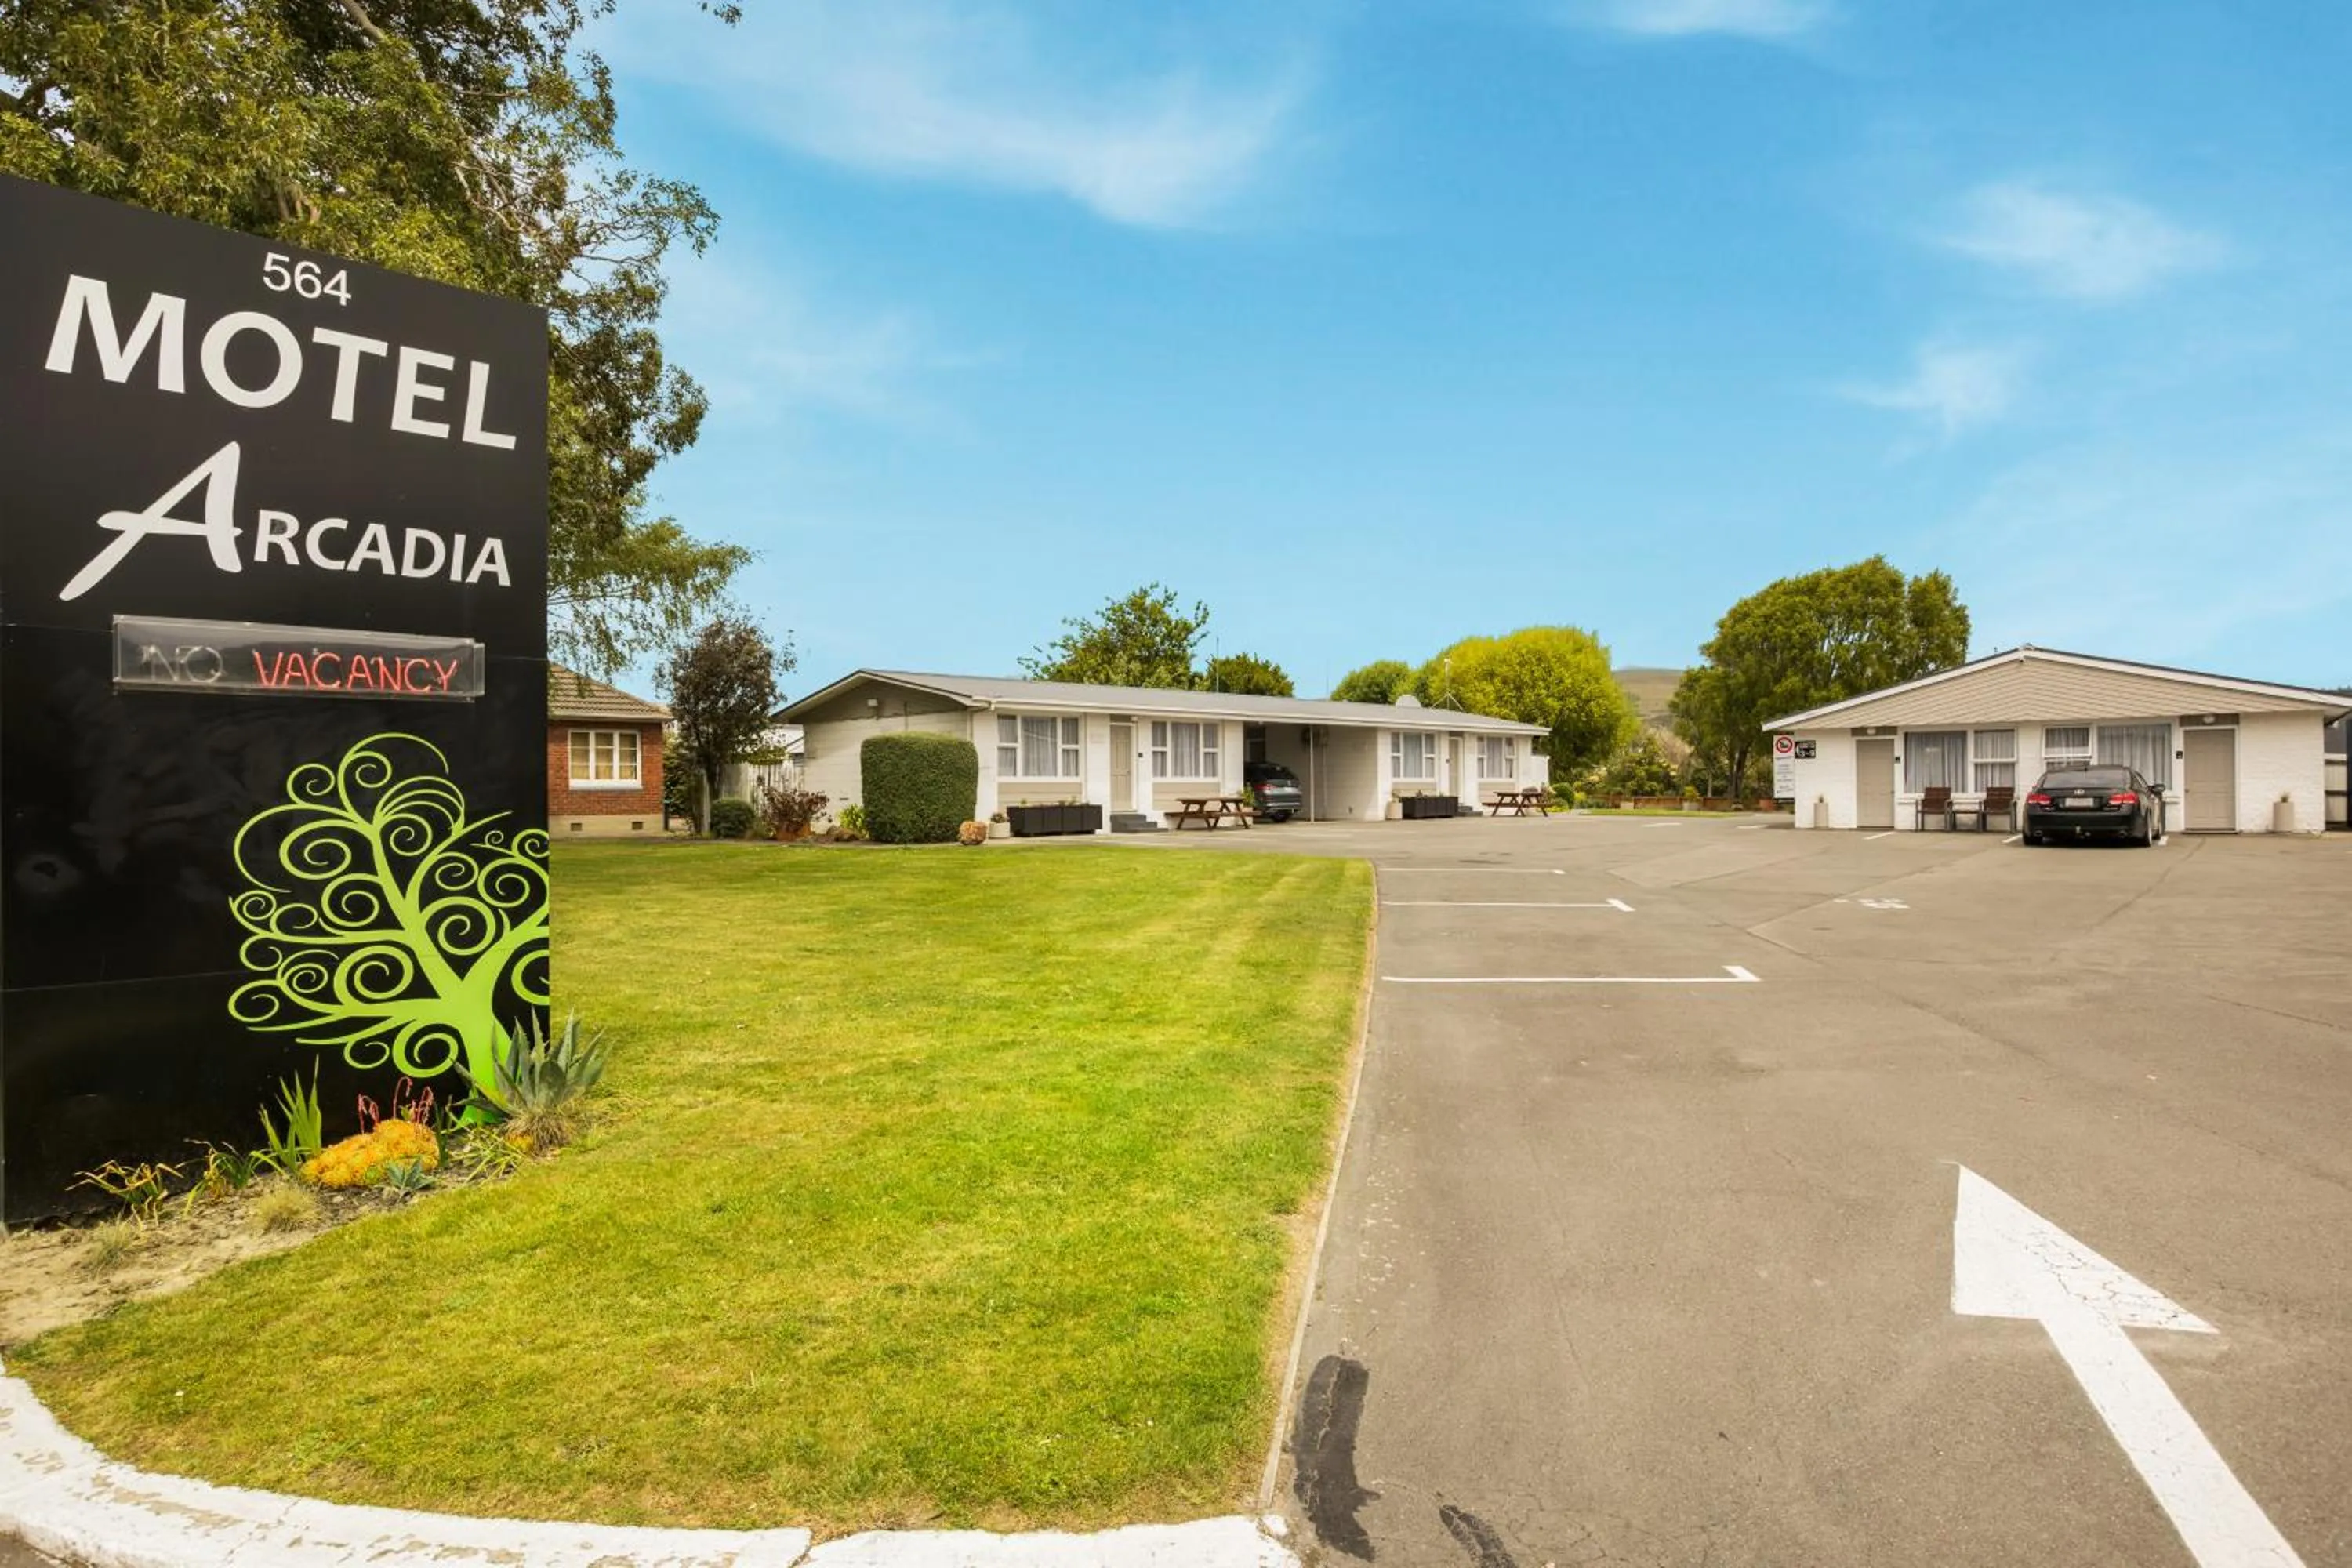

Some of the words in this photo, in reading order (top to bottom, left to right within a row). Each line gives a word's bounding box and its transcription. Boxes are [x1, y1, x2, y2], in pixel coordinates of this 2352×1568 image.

[263, 252, 351, 306] 564
[45, 274, 516, 451] MOTEL
[140, 644, 224, 683] NO
[253, 651, 457, 693] VACANCY
